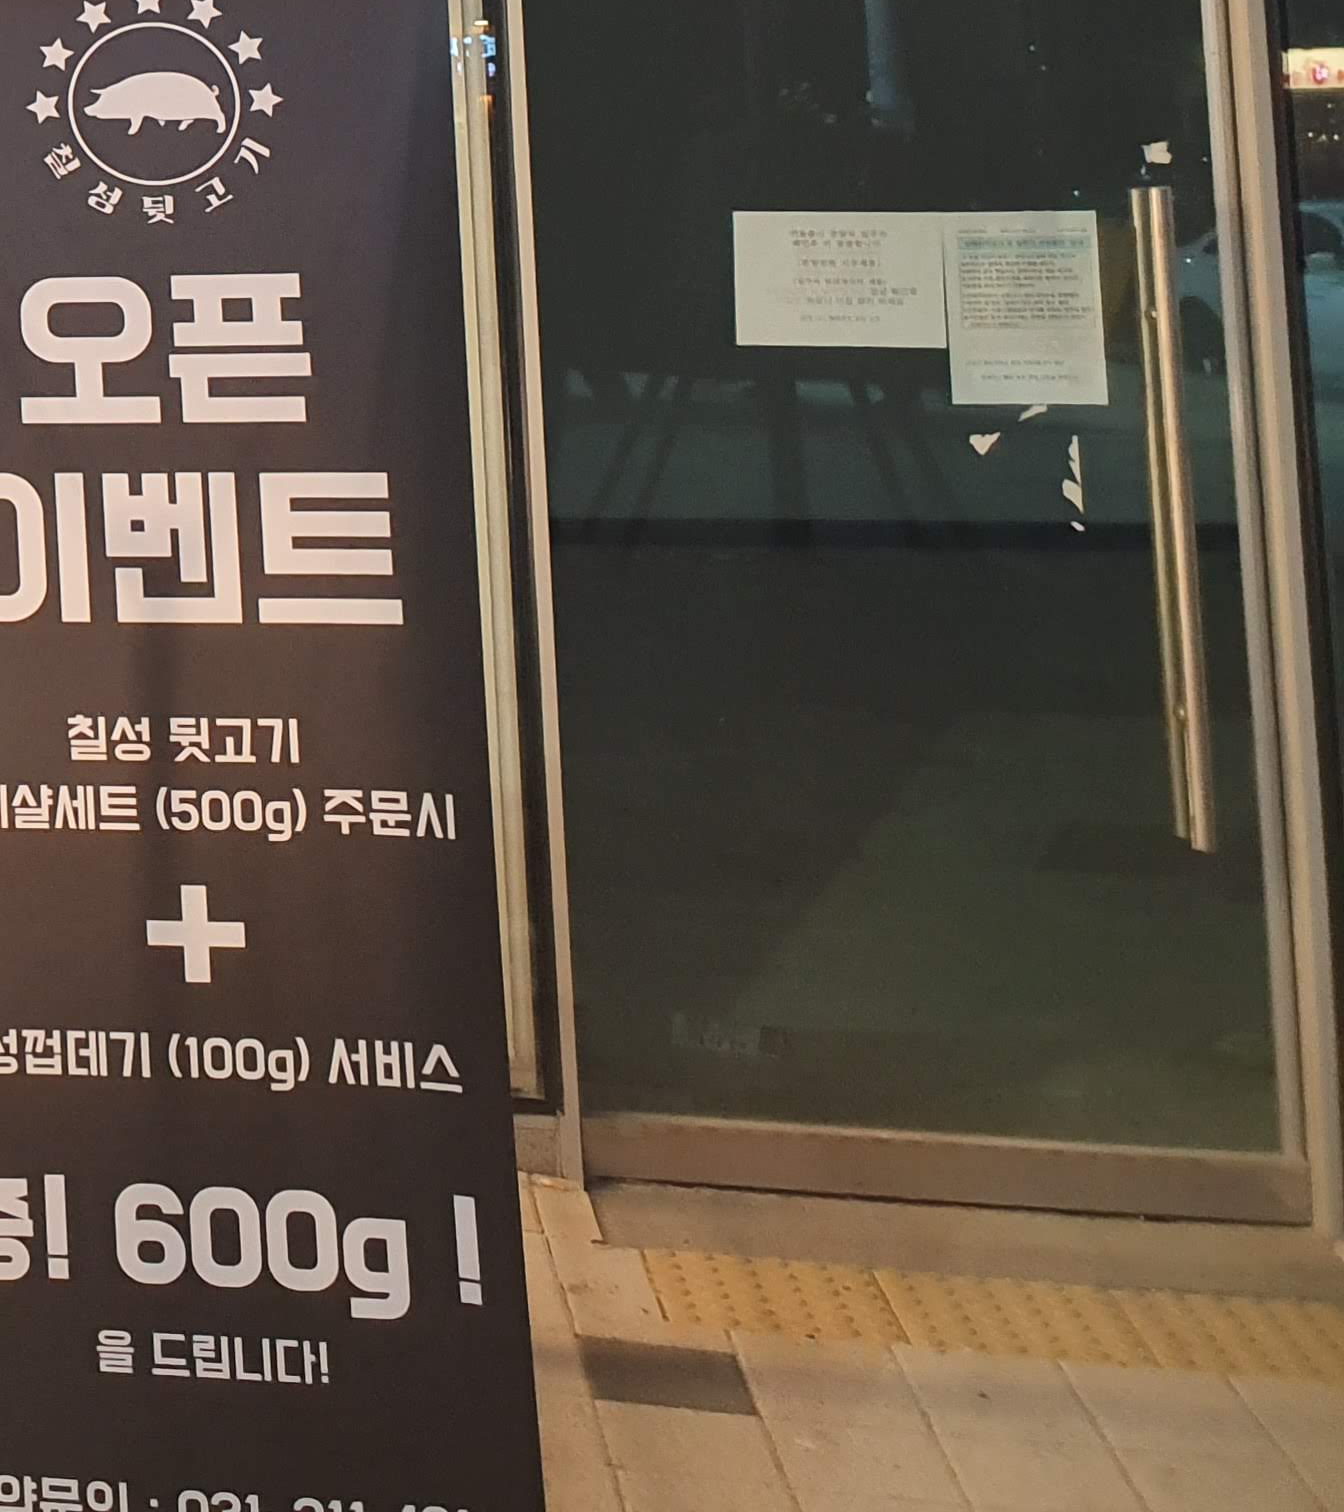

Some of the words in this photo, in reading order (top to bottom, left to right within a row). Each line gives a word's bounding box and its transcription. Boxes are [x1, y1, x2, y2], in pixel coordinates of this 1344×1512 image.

[42, 136, 272, 225] 칠성뒷고기
[20, 272, 312, 424] 오픈
[67, 714, 151, 762] 칠성
[169, 717, 300, 764] 뒷고기
[156, 787, 307, 842] (500g)
[323, 788, 456, 840] 주문시
[168, 1033, 310, 1092] (100g)
[328, 1038, 463, 1094] 서비스
[114, 1182, 411, 1320] 600g
[96, 1329, 135, 1374] 을
[151, 1332, 330, 1385] 드립니다!
